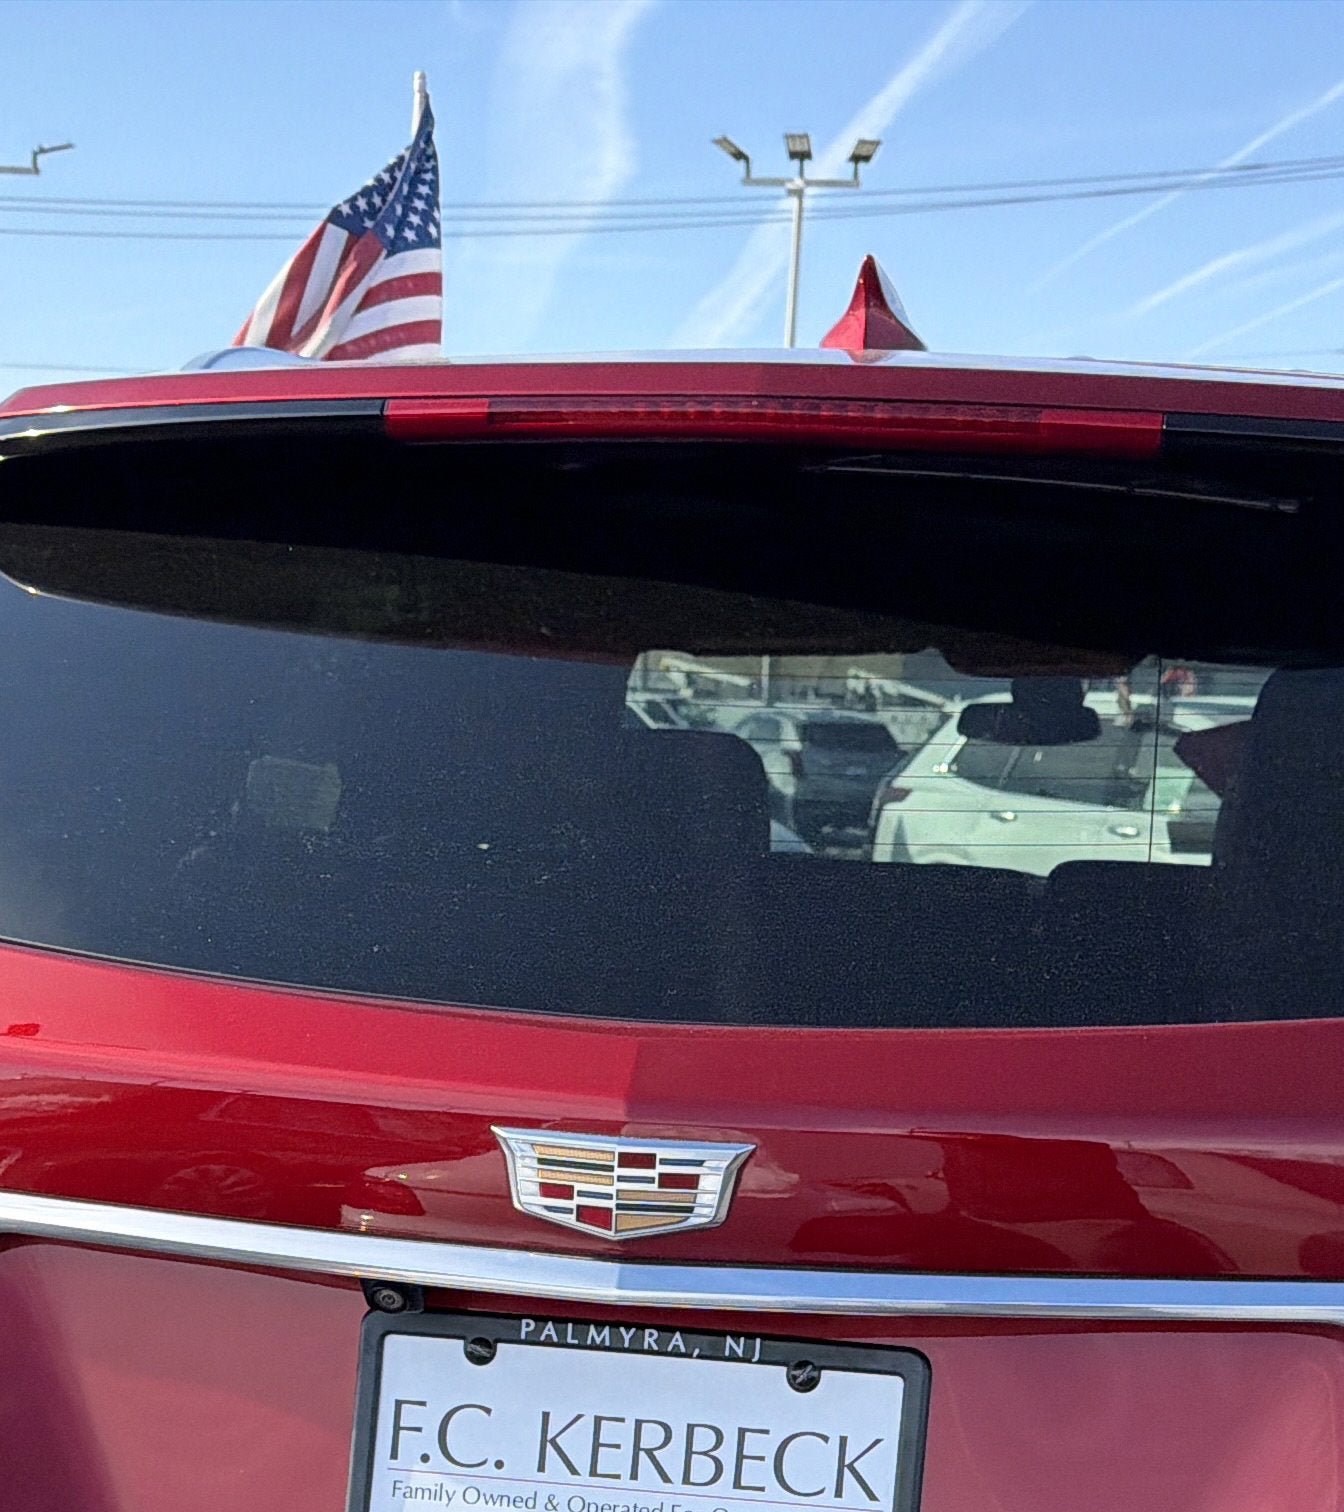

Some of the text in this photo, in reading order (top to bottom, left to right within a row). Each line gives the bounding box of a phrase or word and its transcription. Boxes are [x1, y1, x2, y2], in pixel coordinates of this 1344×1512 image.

[520, 1318, 763, 1362] PALMYRA, NJ
[388, 1398, 885, 1502] F.C. KERBECK
[391, 1480, 456, 1506] Family
[462, 1486, 538, 1512] Owned
[543, 1493, 560, 1512] &
